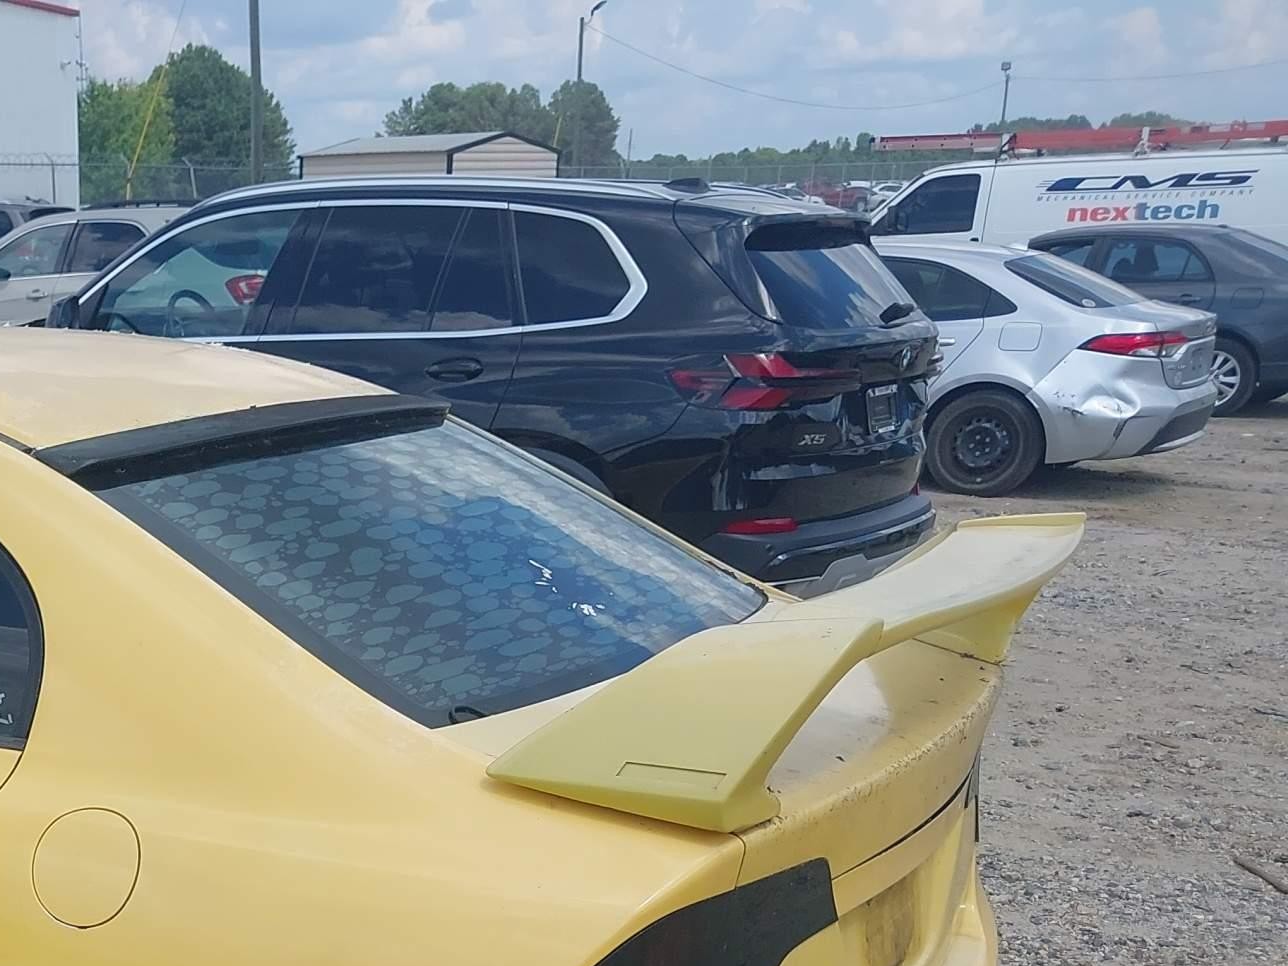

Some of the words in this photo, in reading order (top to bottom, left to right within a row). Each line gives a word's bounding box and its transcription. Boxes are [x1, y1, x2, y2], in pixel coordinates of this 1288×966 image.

[1044, 169, 1260, 192] CMS
[1037, 193, 1116, 202] MECHANICAL
[1126, 191, 1181, 200] SERVICE
[1190, 188, 1255, 197] COMPANY
[1067, 200, 1220, 222] nextech
[797, 433, 827, 446] X5
